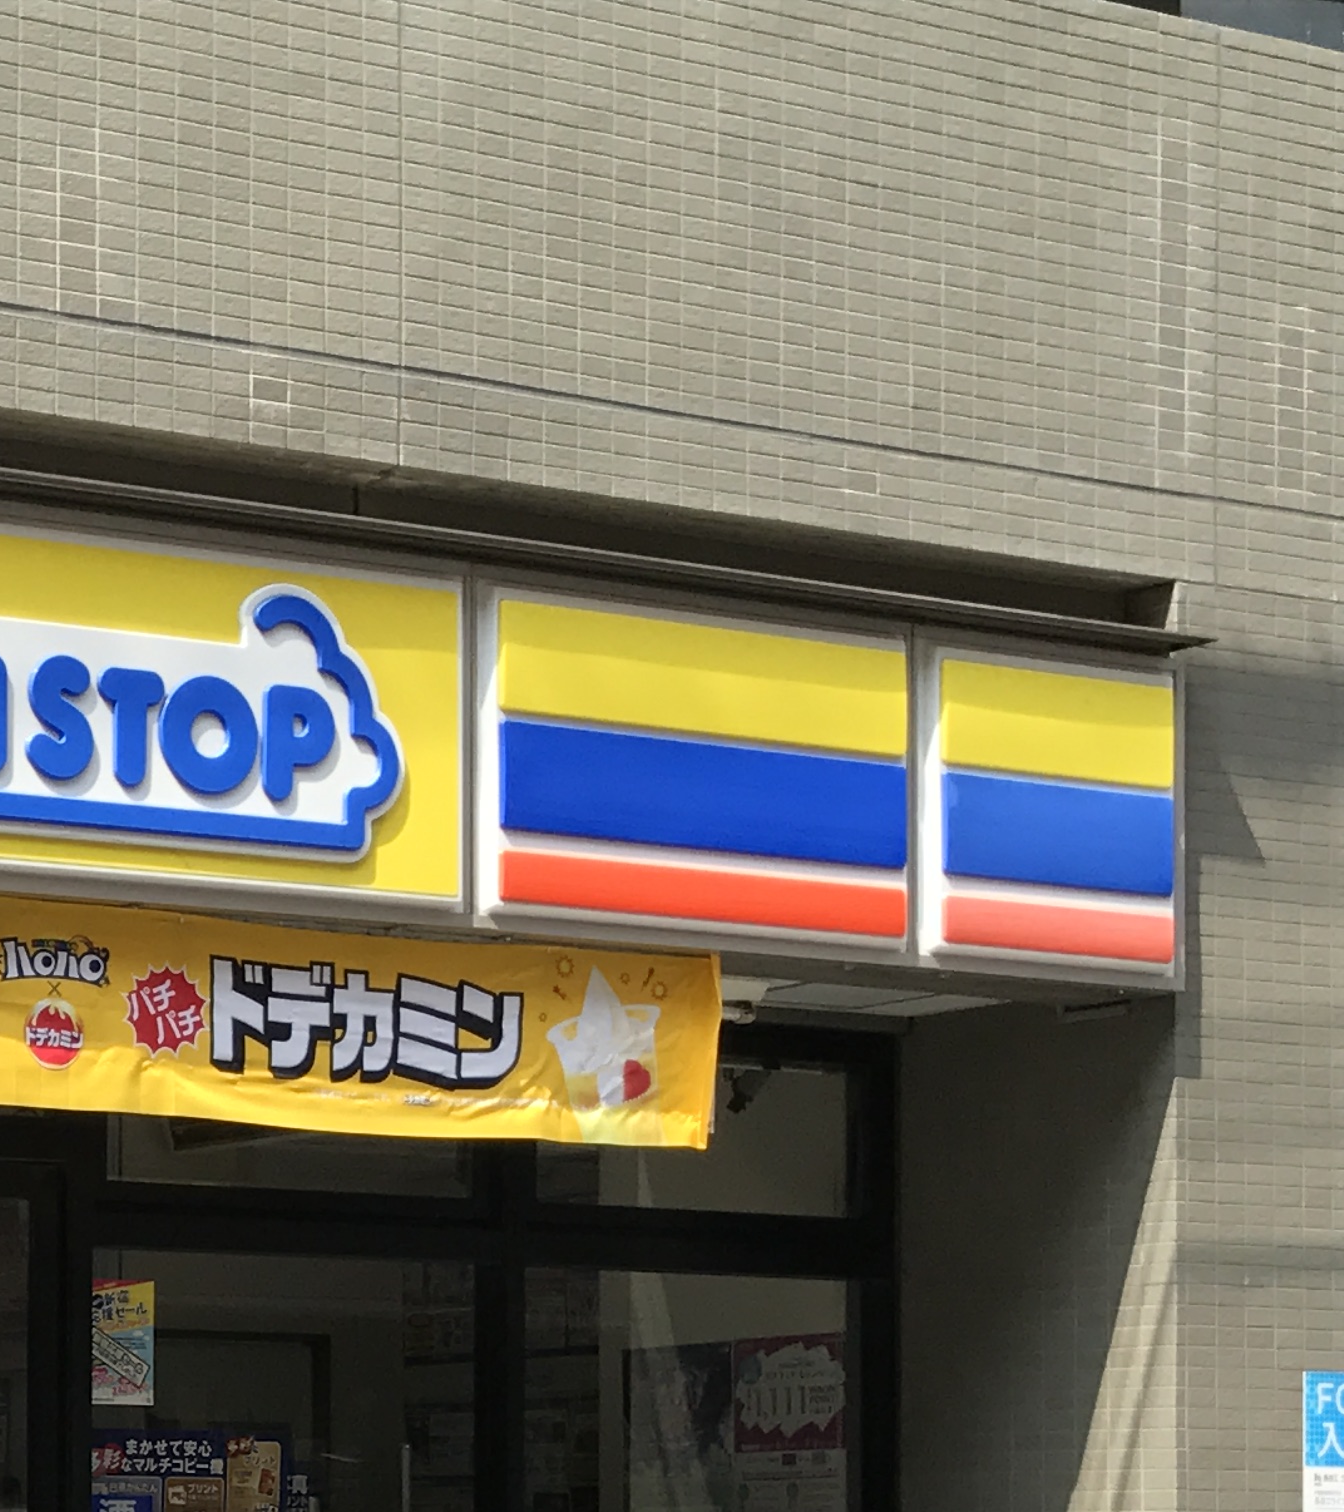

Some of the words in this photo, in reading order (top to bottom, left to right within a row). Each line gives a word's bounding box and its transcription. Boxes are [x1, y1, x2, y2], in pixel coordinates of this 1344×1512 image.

[130, 978, 176, 1022] パチ
[25, 1026, 84, 1049] ドデカミン
[155, 1004, 202, 1045] パチ
[210, 953, 524, 1091] ドデカミン
[124, 1438, 213, 1457] まかせて安心
